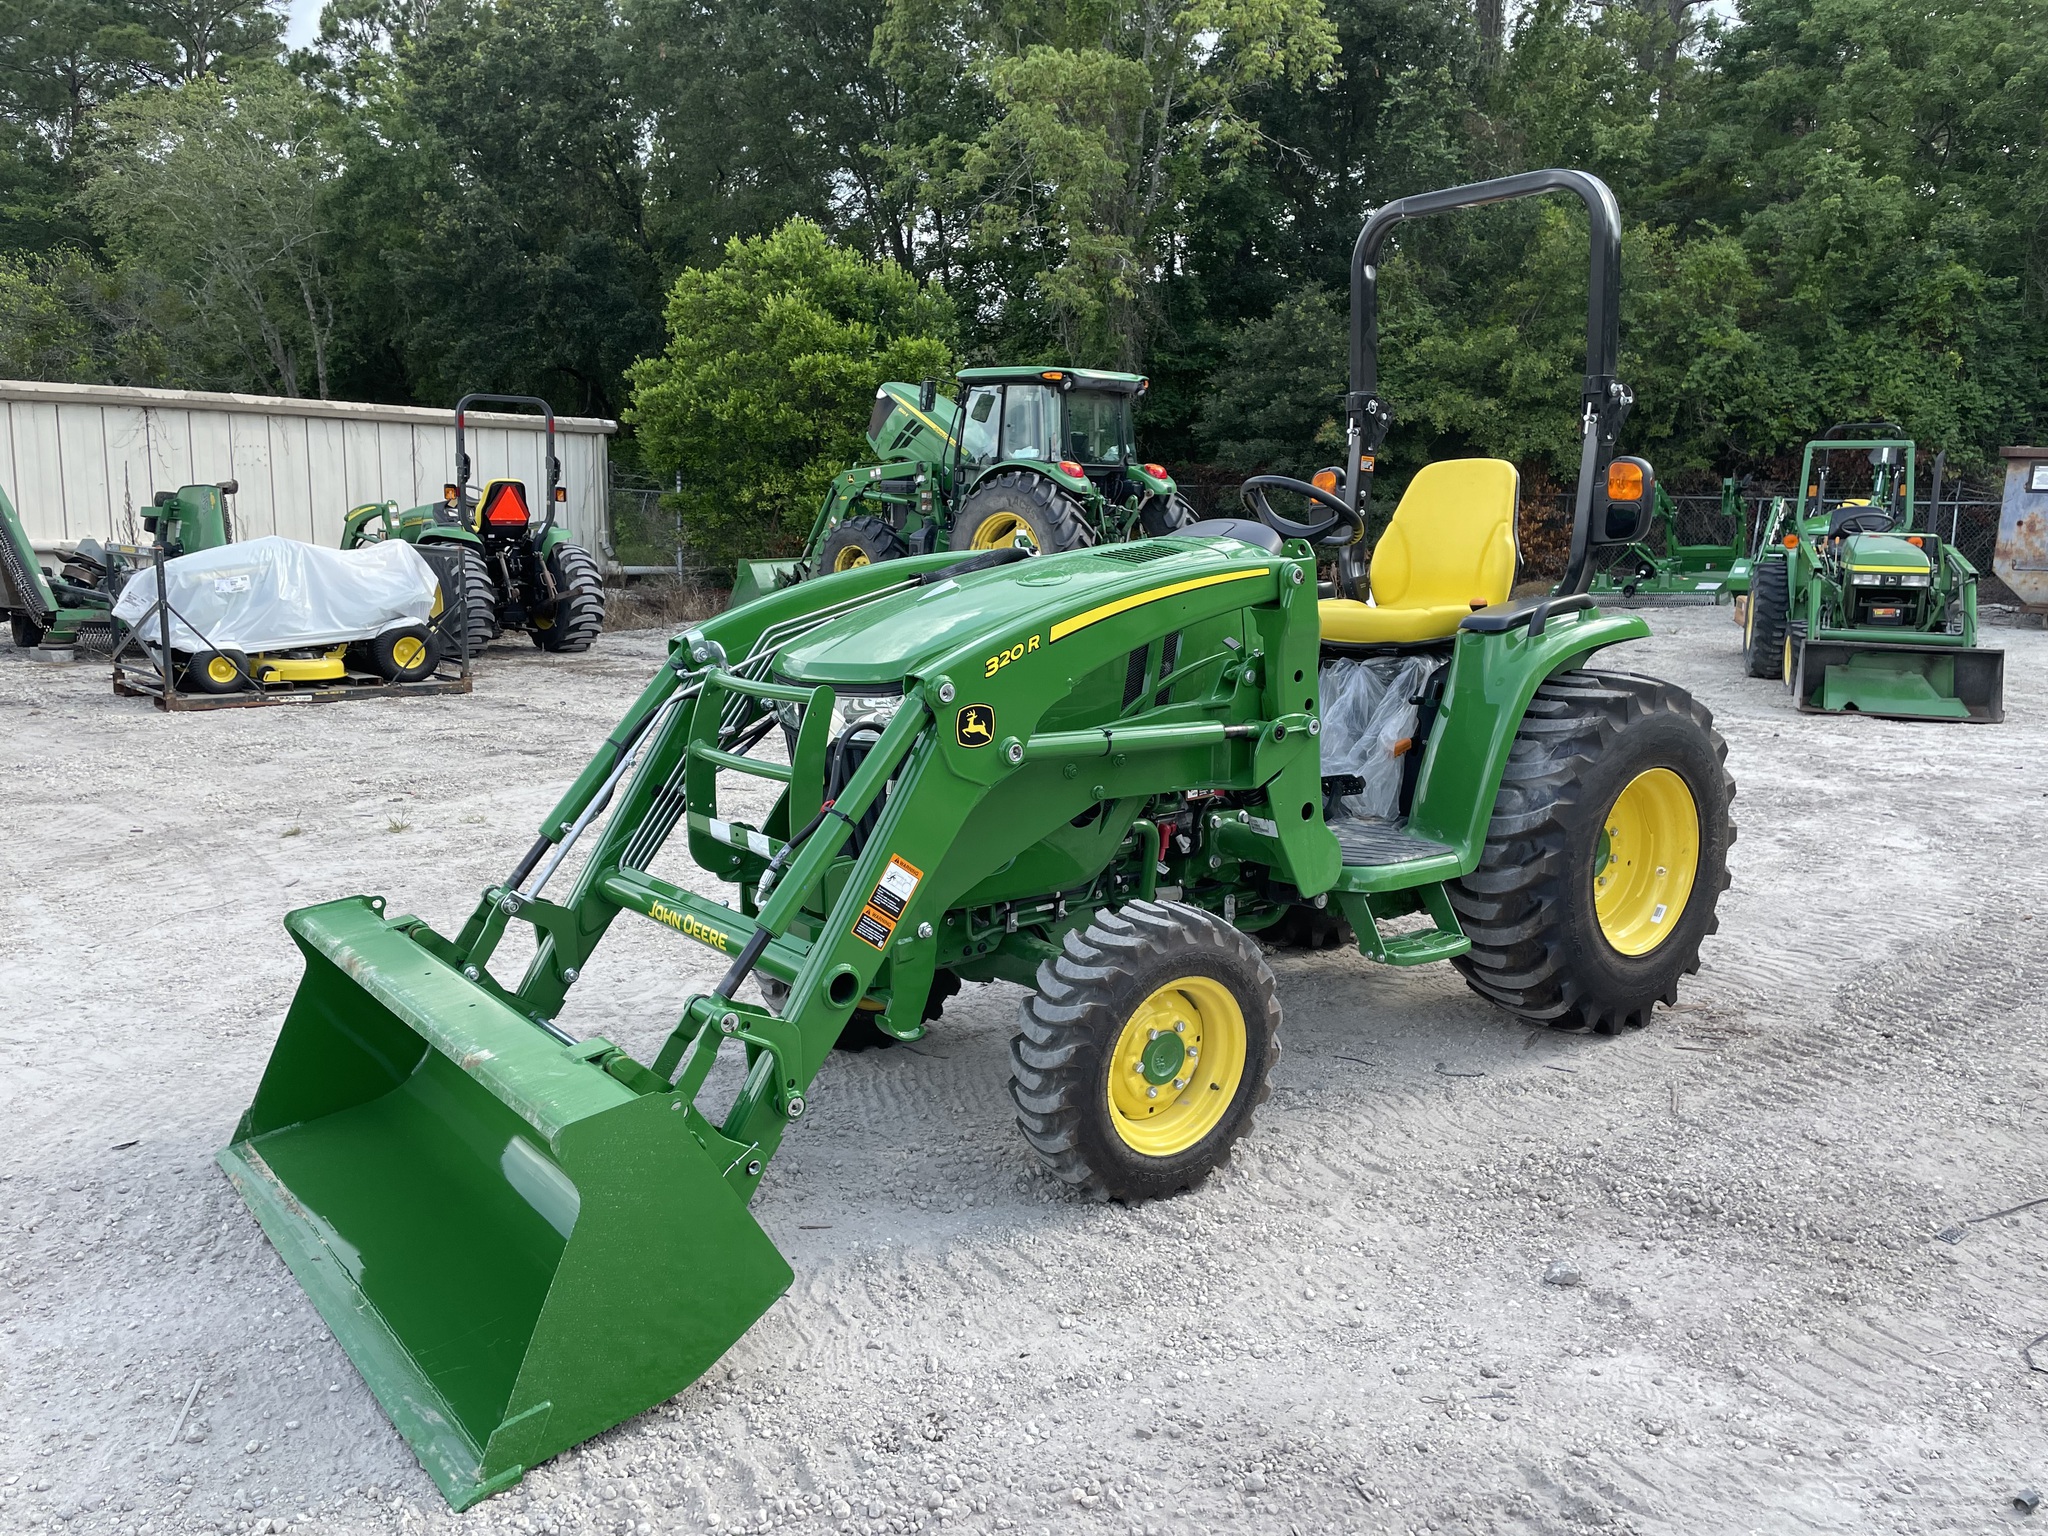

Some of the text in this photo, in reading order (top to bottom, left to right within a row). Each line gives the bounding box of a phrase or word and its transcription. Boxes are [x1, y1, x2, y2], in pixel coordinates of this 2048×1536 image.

[984, 634, 1041, 679] 320 R
[899, 862, 919, 876] WARNING
[648, 899, 729, 951] JOHN DEERE
[872, 912, 892, 927] WARNING
